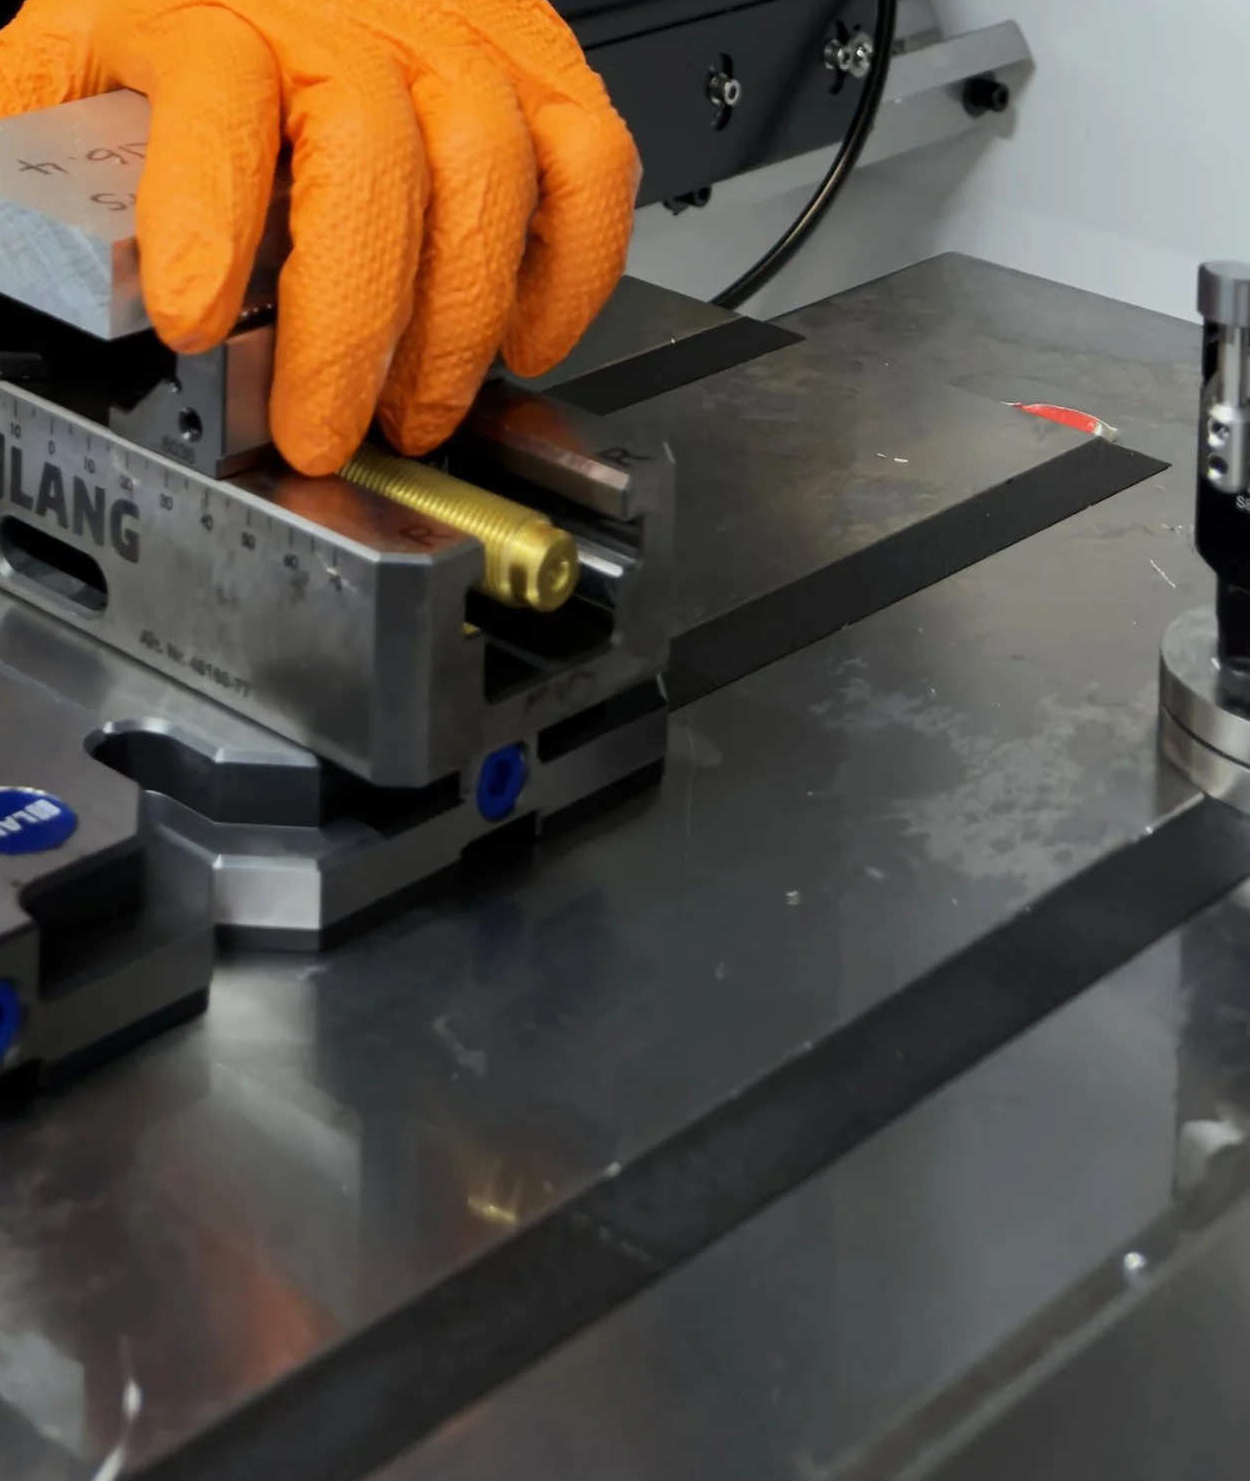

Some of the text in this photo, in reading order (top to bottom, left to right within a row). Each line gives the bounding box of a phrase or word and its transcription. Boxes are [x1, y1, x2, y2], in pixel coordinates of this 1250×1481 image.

[10, 422, 22, 439] 10
[83, 457, 96, 474] 10
[9, 446, 141, 565] LANG
